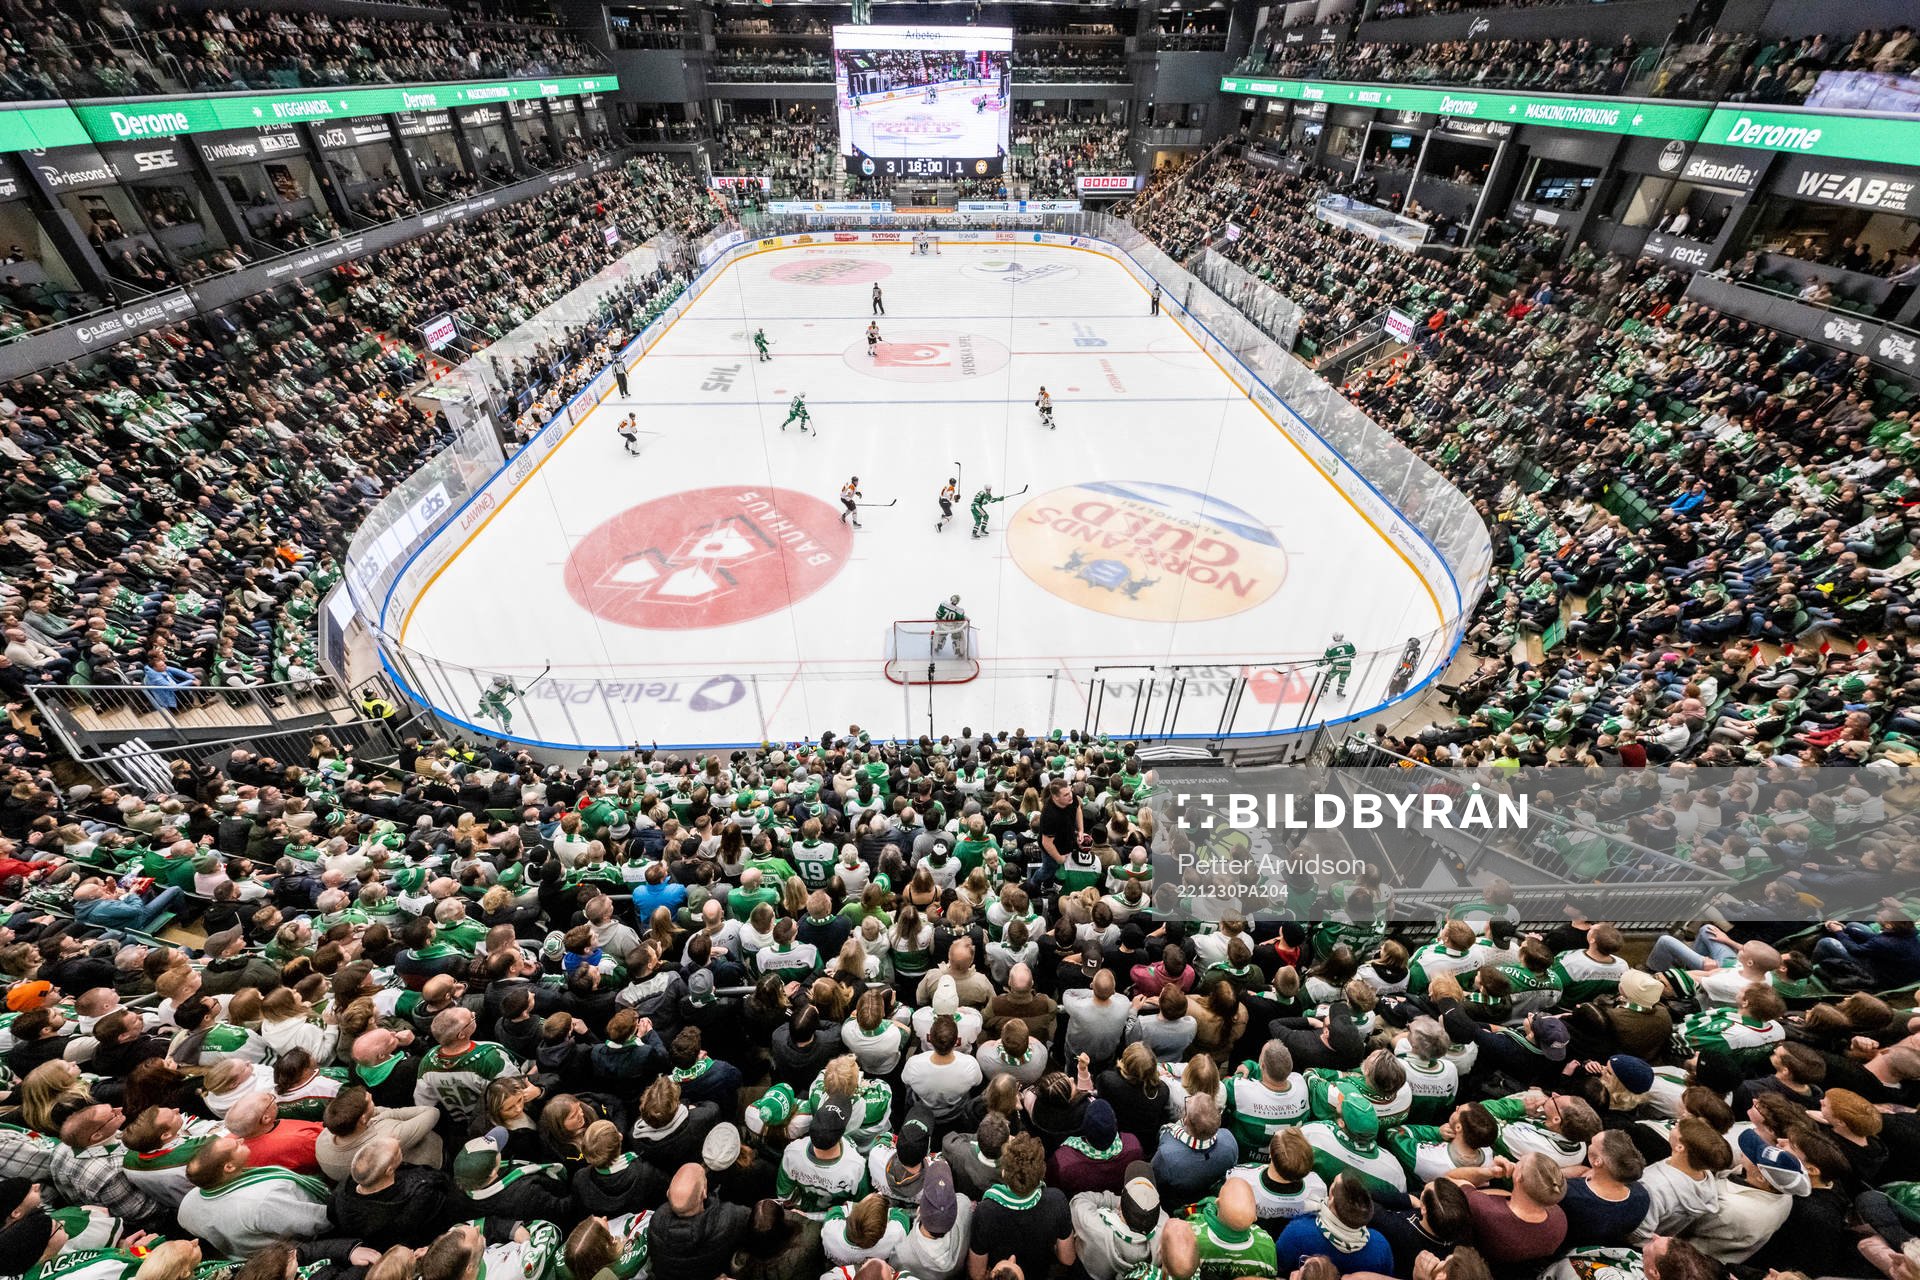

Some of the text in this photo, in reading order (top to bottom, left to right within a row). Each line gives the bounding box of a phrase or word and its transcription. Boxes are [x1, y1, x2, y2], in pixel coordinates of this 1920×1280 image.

[905, 29, 941, 40] Arbeten
[272, 100, 333, 118] BYGGHANDEL
[402, 92, 436, 109] Derome
[1439, 95, 1478, 115] Derome
[110, 110, 190, 137] Derome
[1525, 103, 1620, 126] MASKINUTHYRNING
[1726, 117, 1822, 150] Derome
[211, 143, 257, 157] Wihlborgs
[886, 161, 895, 173] 3
[907, 160, 943, 173] 18:00
[956, 161, 964, 173] 1
[1797, 171, 1888, 205] WEAB
[737, 490, 833, 568] BAUHAUS
[1071, 500, 1240, 567] GULD
[1027, 506, 1261, 598] NORRLANDS
[529, 680, 683, 705] Telia Play
[799, 861, 826, 881] 19
